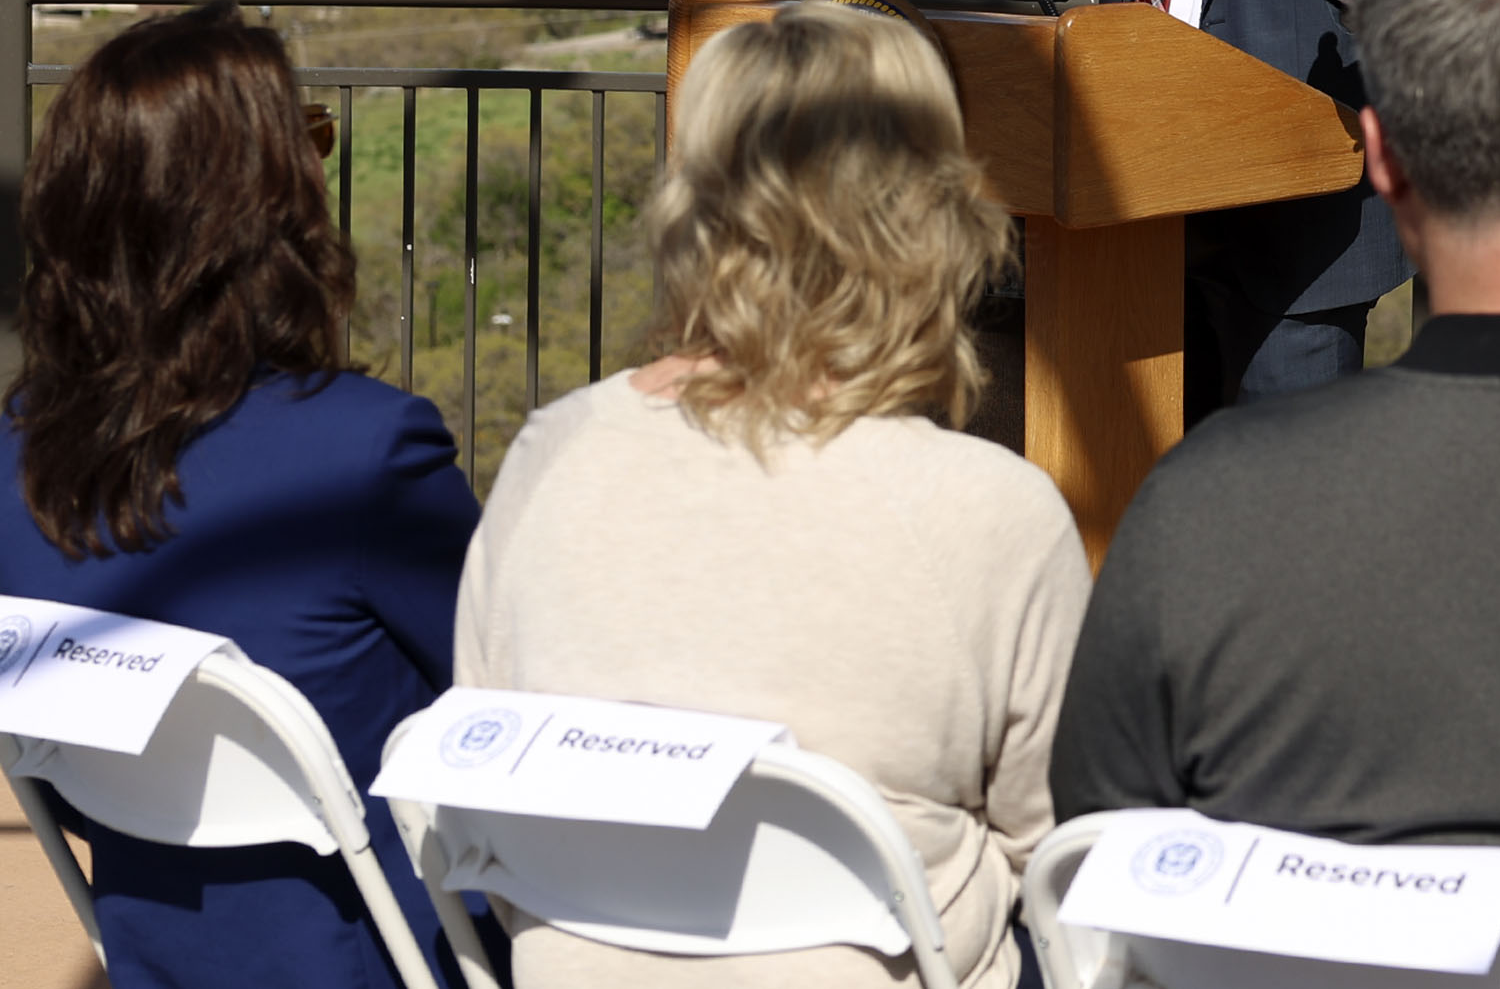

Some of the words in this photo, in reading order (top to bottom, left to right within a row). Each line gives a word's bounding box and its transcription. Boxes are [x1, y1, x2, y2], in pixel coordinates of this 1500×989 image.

[53, 637, 165, 672] Reserved
[557, 727, 714, 760] Reserved
[1276, 853, 1466, 894] Reserved
